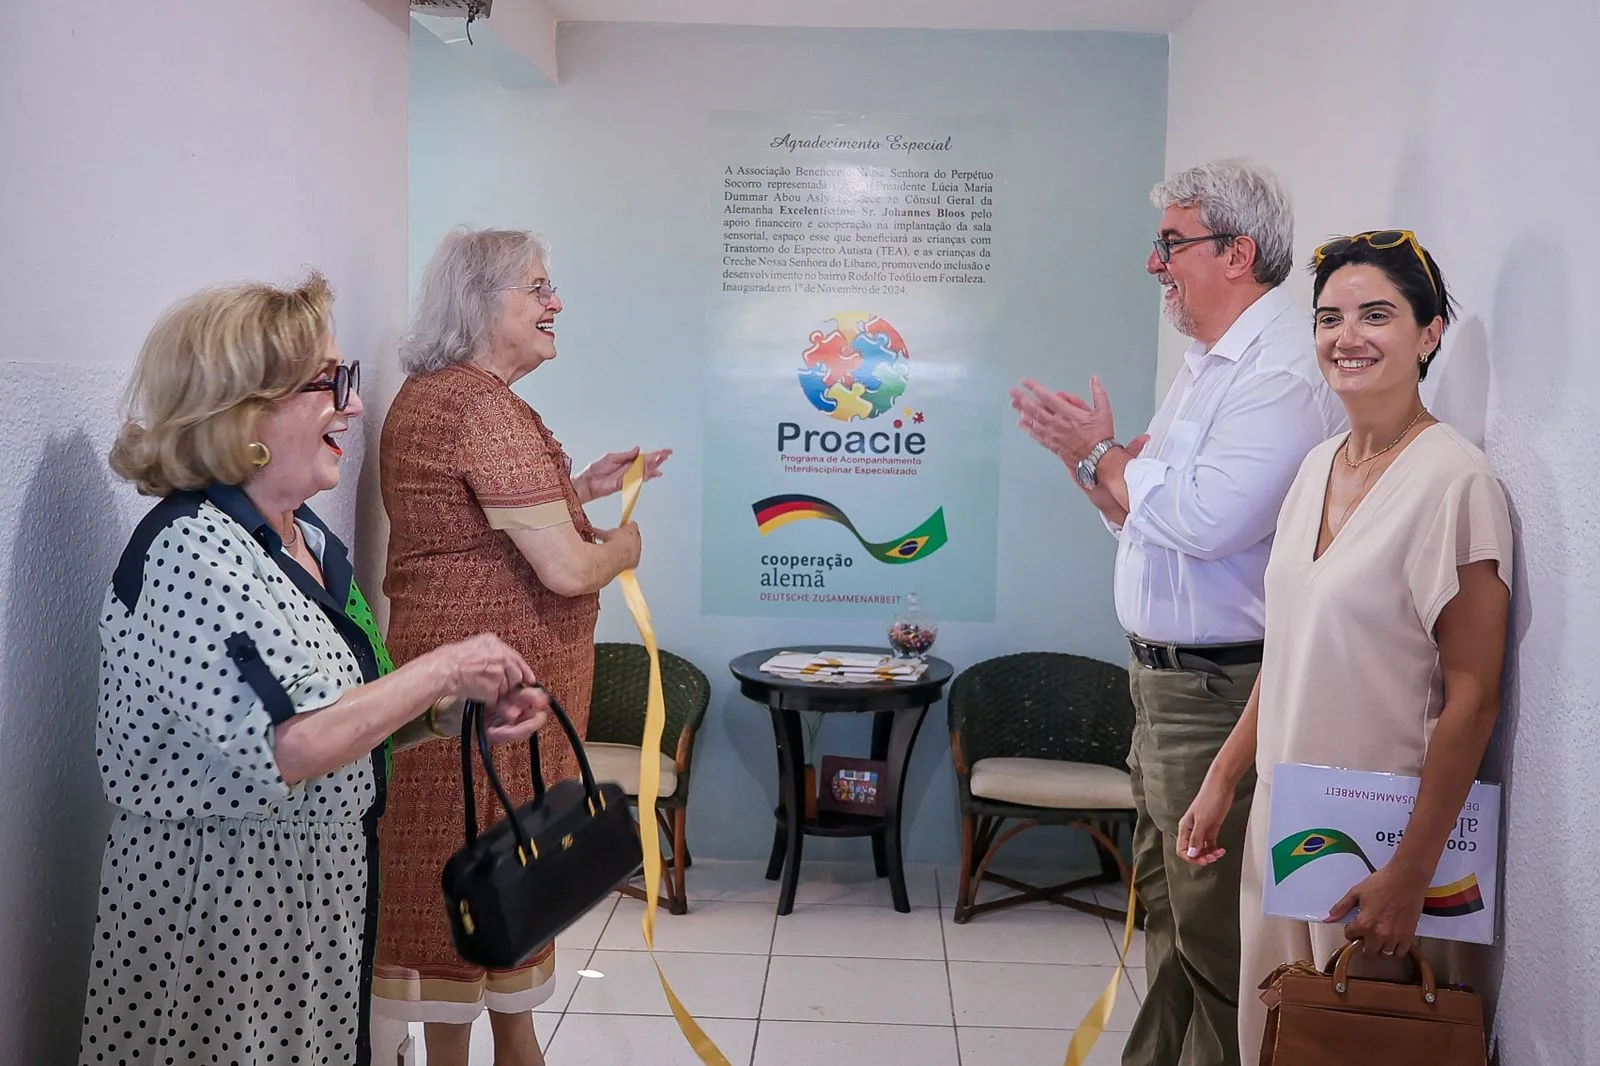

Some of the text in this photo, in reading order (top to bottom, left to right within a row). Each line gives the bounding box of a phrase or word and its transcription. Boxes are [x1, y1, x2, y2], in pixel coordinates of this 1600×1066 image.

[770, 133, 952, 155] Agradecimento Especial
[724, 166, 733, 175] A
[737, 166, 790, 177] Associação
[796, 166, 850, 177] Beneficen
[890, 168, 929, 178] Senhora
[934, 169, 946, 178] do
[951, 169, 993, 181] Perpétuo
[724, 179, 762, 188] Socorro
[767, 180, 827, 191] representada
[876, 181, 926, 192] residente
[932, 182, 958, 192] Lúcia
[964, 183, 993, 193] Maria
[724, 191, 768, 201] Dummar
[773, 193, 801, 202] Abou
[838, 194, 881, 206] gdece
[905, 194, 940, 204] Cônsul
[947, 196, 974, 205] Geral
[980, 196, 993, 206] da
[724, 205, 773, 214] Alemanha
[862, 206, 876, 217] Sr.
[883, 207, 931, 217] Johannes
[937, 208, 965, 218] Bloos
[971, 209, 992, 220] pelo
[723, 218, 750, 229] apoio
[755, 217, 802, 228] financeiro
[818, 220, 872, 231] cooperação
[877, 222, 888, 230] na
[894, 220, 951, 232] implantação
[956, 222, 968, 231] da
[973, 222, 992, 231] sala
[772, 233, 805, 243] espaço
[834, 234, 851, 244] que
[856, 233, 908, 243] beneficiará
[927, 235, 966, 246] crianças
[723, 243, 774, 253] Transtorno
[778, 244, 790, 254] do
[794, 244, 835, 256] Espectro
[838, 246, 872, 255] Autista
[936, 248, 976, 259] crianças
[979, 248, 991, 257] da
[722, 256, 991, 271] Creche Nossa Senhora do Líbano, promovendo inclusão e
[722, 269, 804, 280] desenvolvimento
[819, 271, 846, 281] bairro
[848, 271, 886, 281] Rodolfo
[888, 272, 923, 282] Teófilo
[939, 273, 986, 284] Fortaleza.
[722, 282, 775, 294] Inaugurada
[804, 283, 815, 293] de
[817, 284, 868, 294] Novembro
[869, 285, 880, 294] de
[777, 419, 926, 455] Proacie
[780, 454, 922, 466] Programa de Acompanhamento
[784, 465, 917, 476] Interdisciplinar Especializado
[761, 553, 853, 571] cooperação
[760, 568, 825, 588] alemã
[760, 592, 901, 604] DEUTSCHE ZUSAMMENARBEIT
[1324, 786, 1416, 804] USAMMENARBEIT
